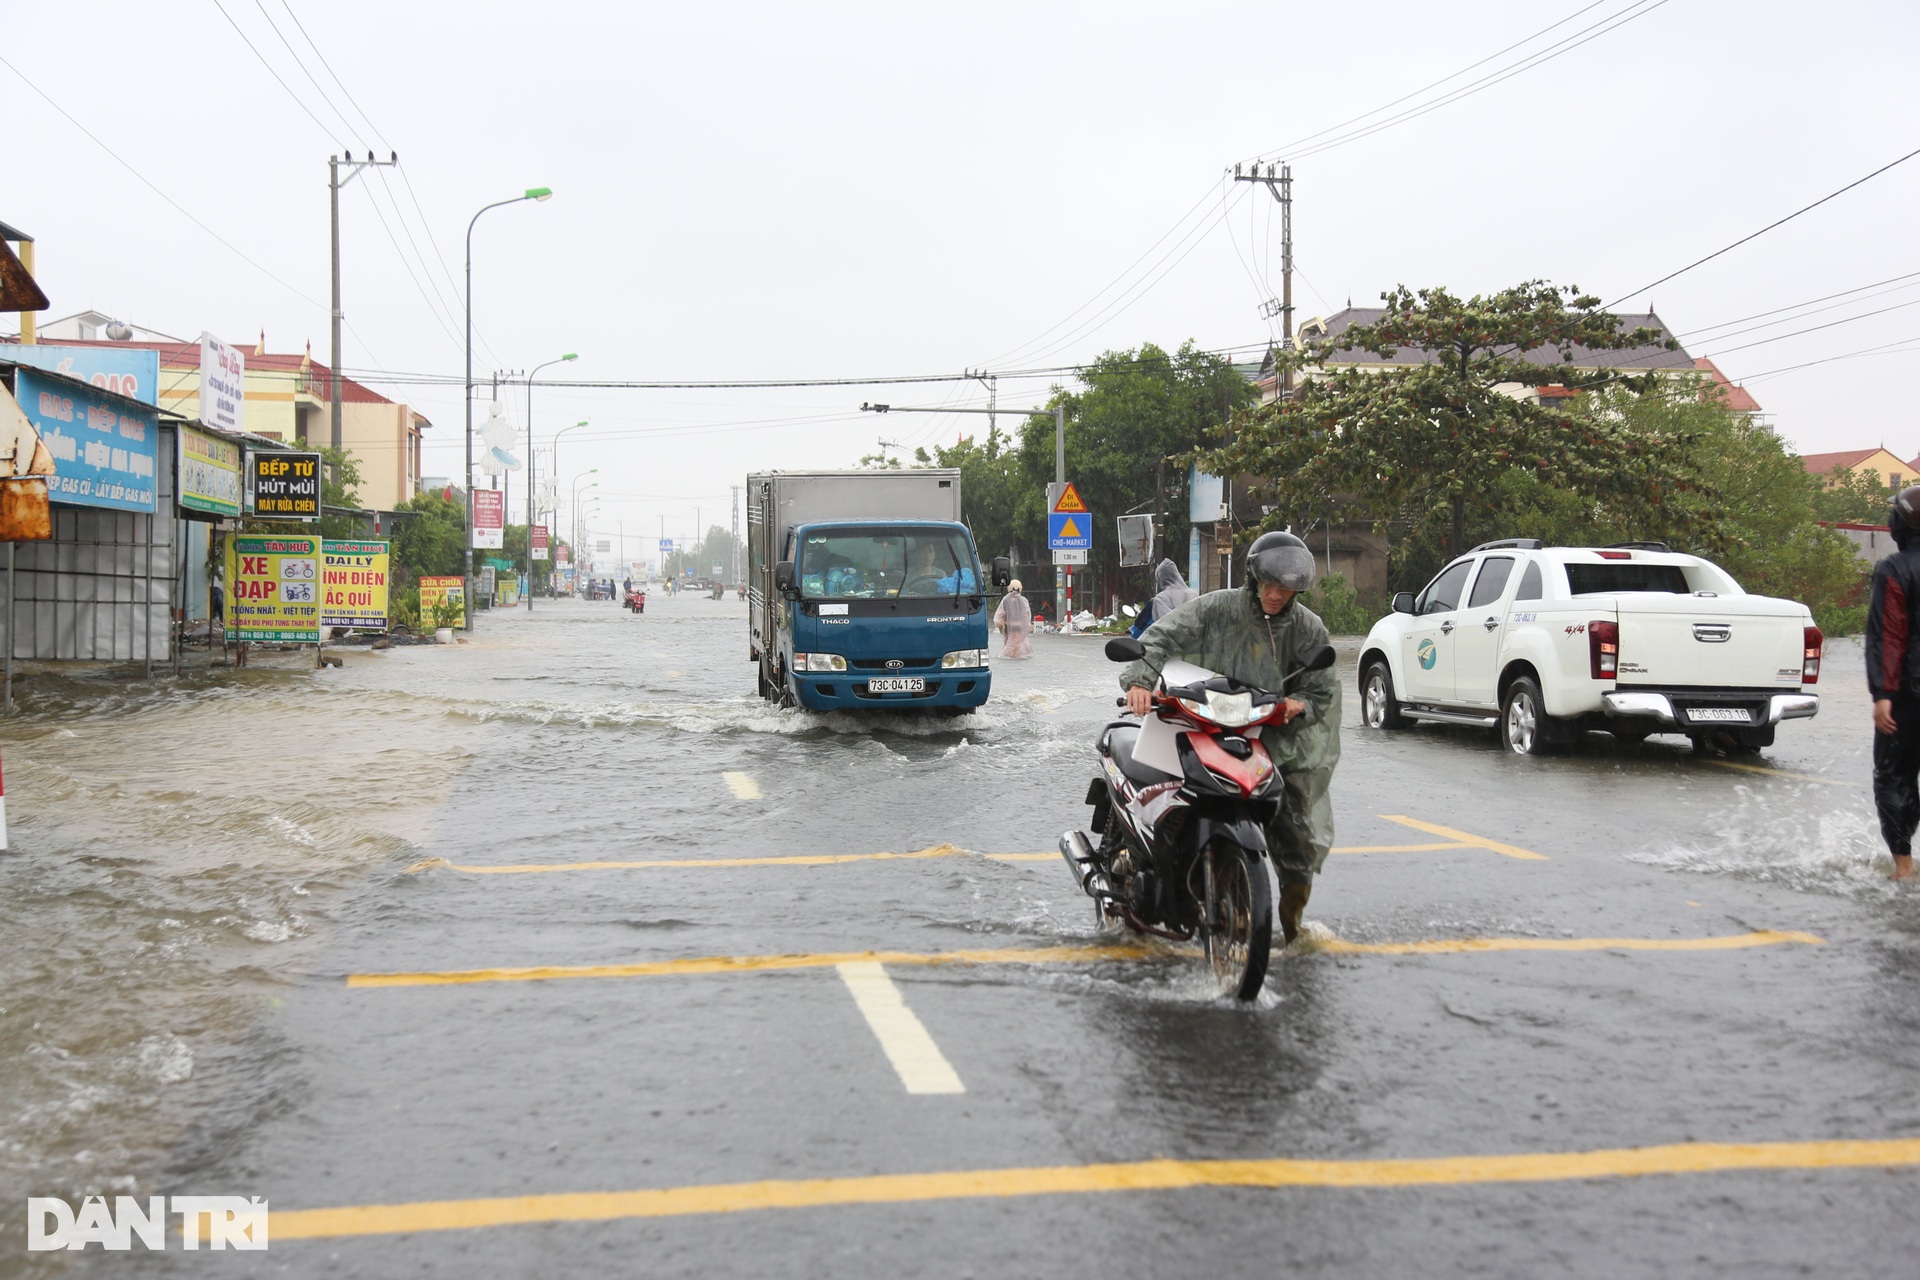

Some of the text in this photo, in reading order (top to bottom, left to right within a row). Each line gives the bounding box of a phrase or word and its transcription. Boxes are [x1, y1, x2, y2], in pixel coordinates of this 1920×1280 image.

[39, 391, 74, 423] GAS
[88, 404, 116, 433] BẾP
[119, 416, 145, 442] GAS
[259, 457, 315, 477] BẾP TỪ
[61, 477, 79, 495] GAS
[125, 486, 139, 503] GAS
[258, 478, 287, 495] HÚT
[258, 495, 316, 513] MÁY RỬA CHÉN
[264, 540, 287, 552] TÂN
[289, 541, 310, 554] HUỆ
[335, 544, 359, 552] TÂN
[362, 545, 385, 554] HUỆ
[242, 557, 269, 575] XE
[356, 556, 373, 566] LÝ
[322, 568, 385, 588] ÌNH ĐIỆN
[421, 577, 462, 587] SỬA CHỮA
[233, 580, 277, 603] ĐẠP
[325, 587, 344, 605] ẮC
[257, 604, 276, 615] NHẤT
[283, 605, 299, 617] VIỆT
[300, 606, 316, 617] TIỆP
